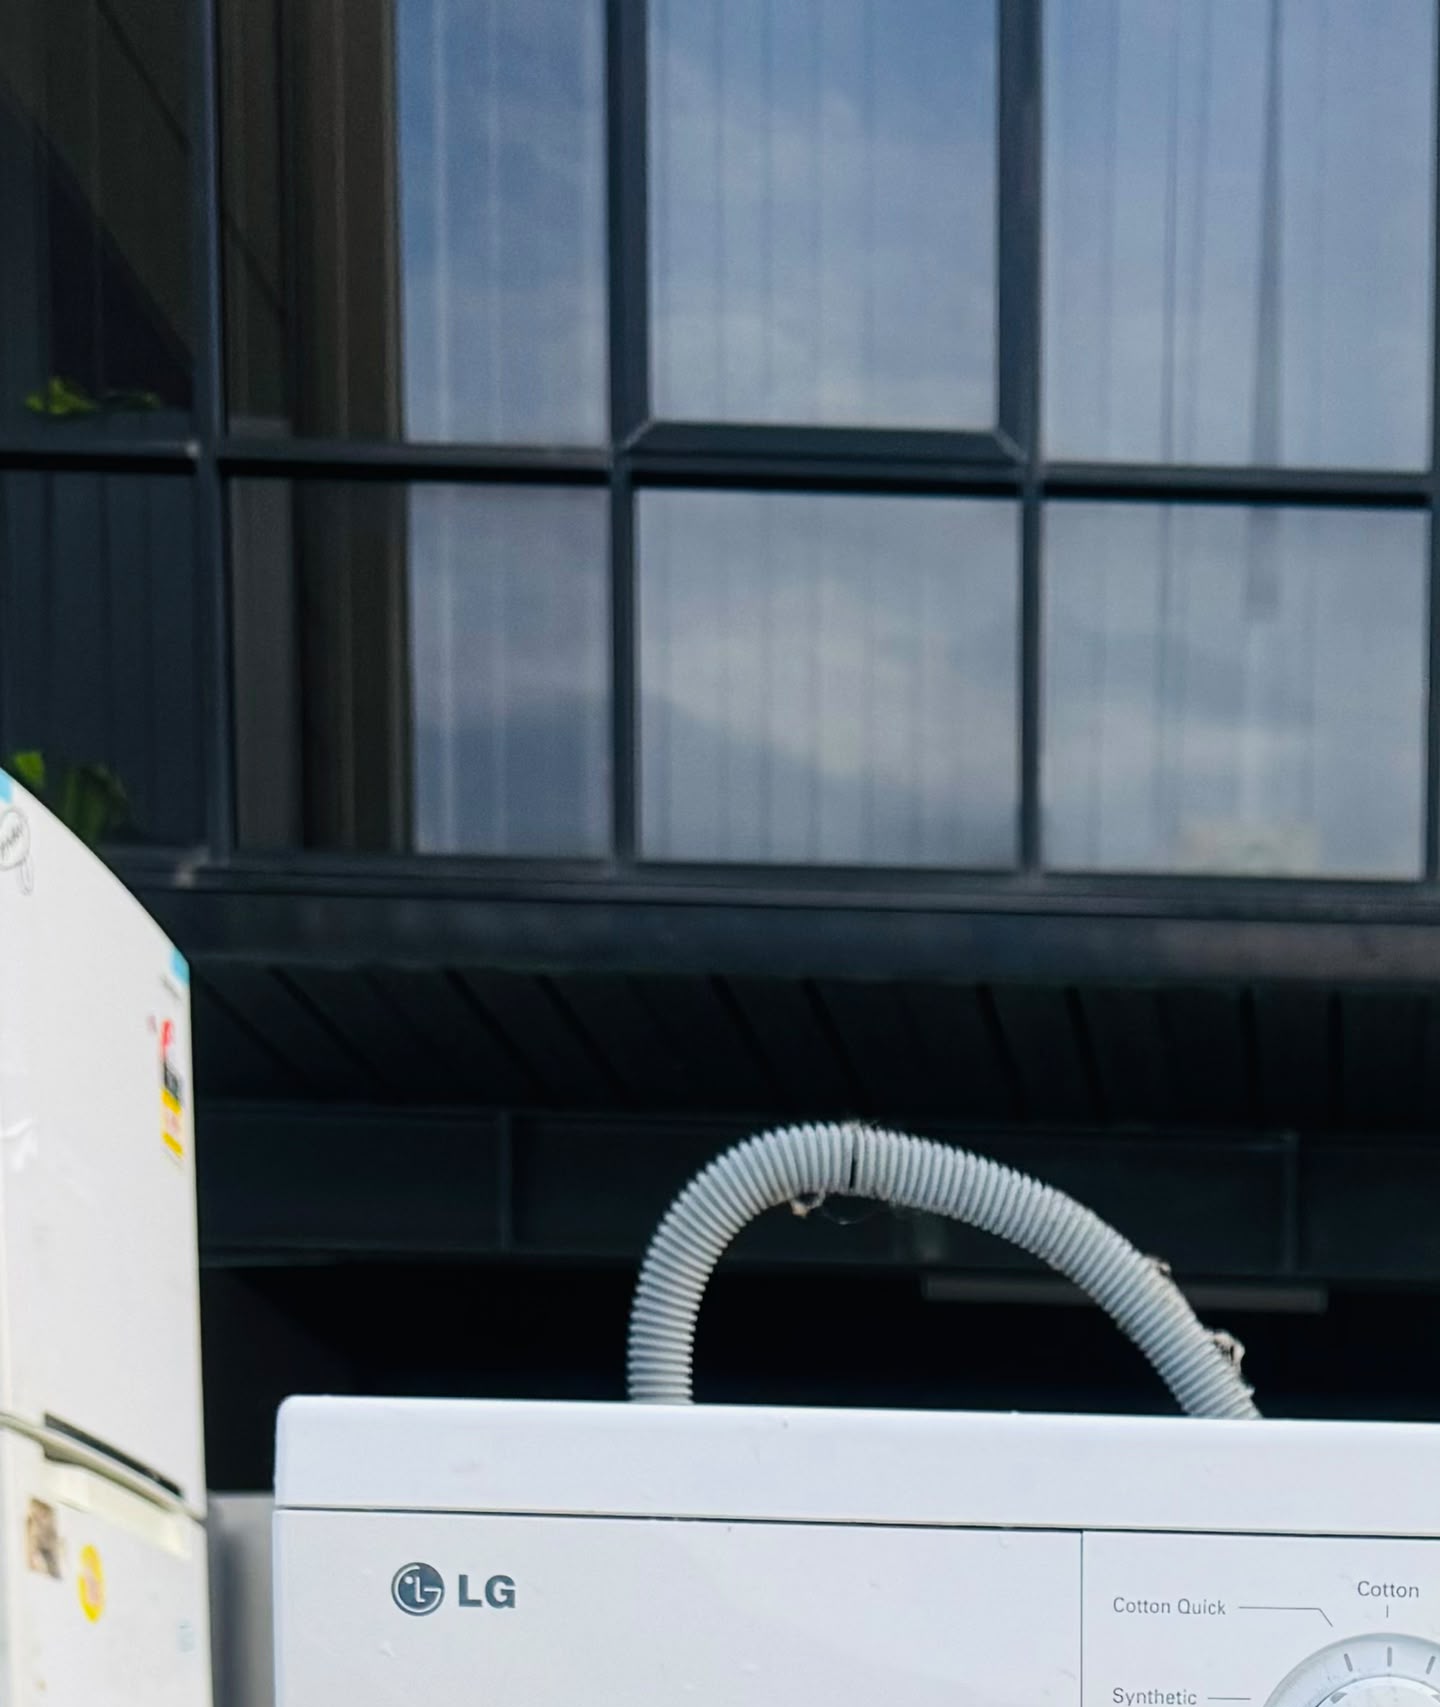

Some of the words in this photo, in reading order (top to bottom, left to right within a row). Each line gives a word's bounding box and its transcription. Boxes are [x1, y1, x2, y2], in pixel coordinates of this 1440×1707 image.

[458, 1574, 516, 1609] LG
[1357, 1581, 1420, 1599] Cotton
[1113, 1596, 1171, 1614] Cotton
[1177, 1598, 1226, 1615] Quick
